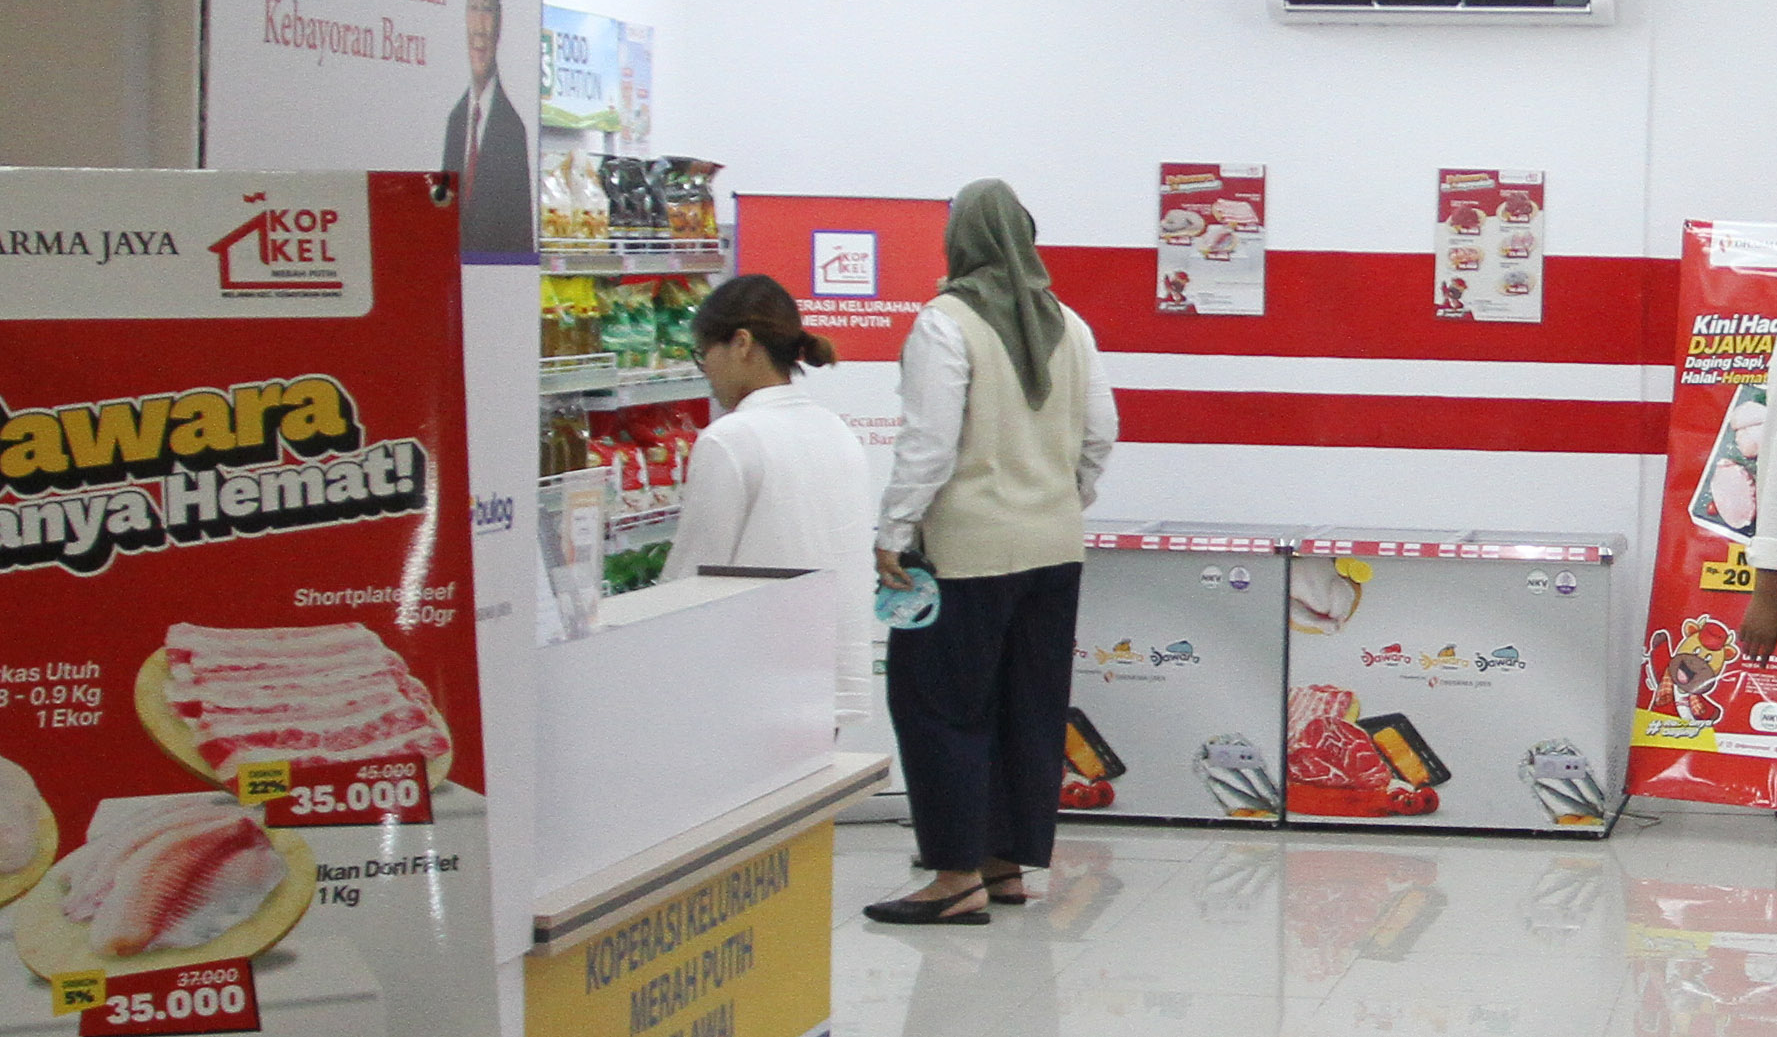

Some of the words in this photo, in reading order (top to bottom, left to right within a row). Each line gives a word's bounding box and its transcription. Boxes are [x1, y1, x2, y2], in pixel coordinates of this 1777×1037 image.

[381, 17, 427, 66] Baru
[270, 209, 339, 232] KOP
[98, 229, 180, 265] JAYA
[271, 239, 336, 262] KEL
[838, 300, 921, 313] KELURAHAN
[850, 316, 891, 328] PUTIH
[1692, 313, 1740, 335] Kini
[1684, 355, 1732, 371] Daging
[1733, 355, 1764, 371] Sapi,
[165, 440, 416, 527] Hemat!
[294, 587, 402, 609] Shortplate
[46, 659, 99, 681] Utuh
[30, 685, 67, 706] 0.9
[72, 683, 102, 707] Kg
[36, 709, 47, 728] 1
[52, 707, 103, 728] Ekor
[356, 762, 417, 780] 45.000
[247, 780, 287, 796] 22%
[289, 779, 421, 816] 35.000
[316, 861, 358, 882] Ikan
[318, 889, 327, 906] 1
[331, 887, 360, 908] Kg
[584, 901, 683, 996] KOPERASI
[686, 847, 790, 944] KELURAHAN
[176, 967, 240, 988] 37.000
[629, 956, 698, 1037] MERAH
[702, 925, 755, 997] PUTIH
[63, 989, 96, 1006] 5%
[105, 984, 246, 1025] 35.000
